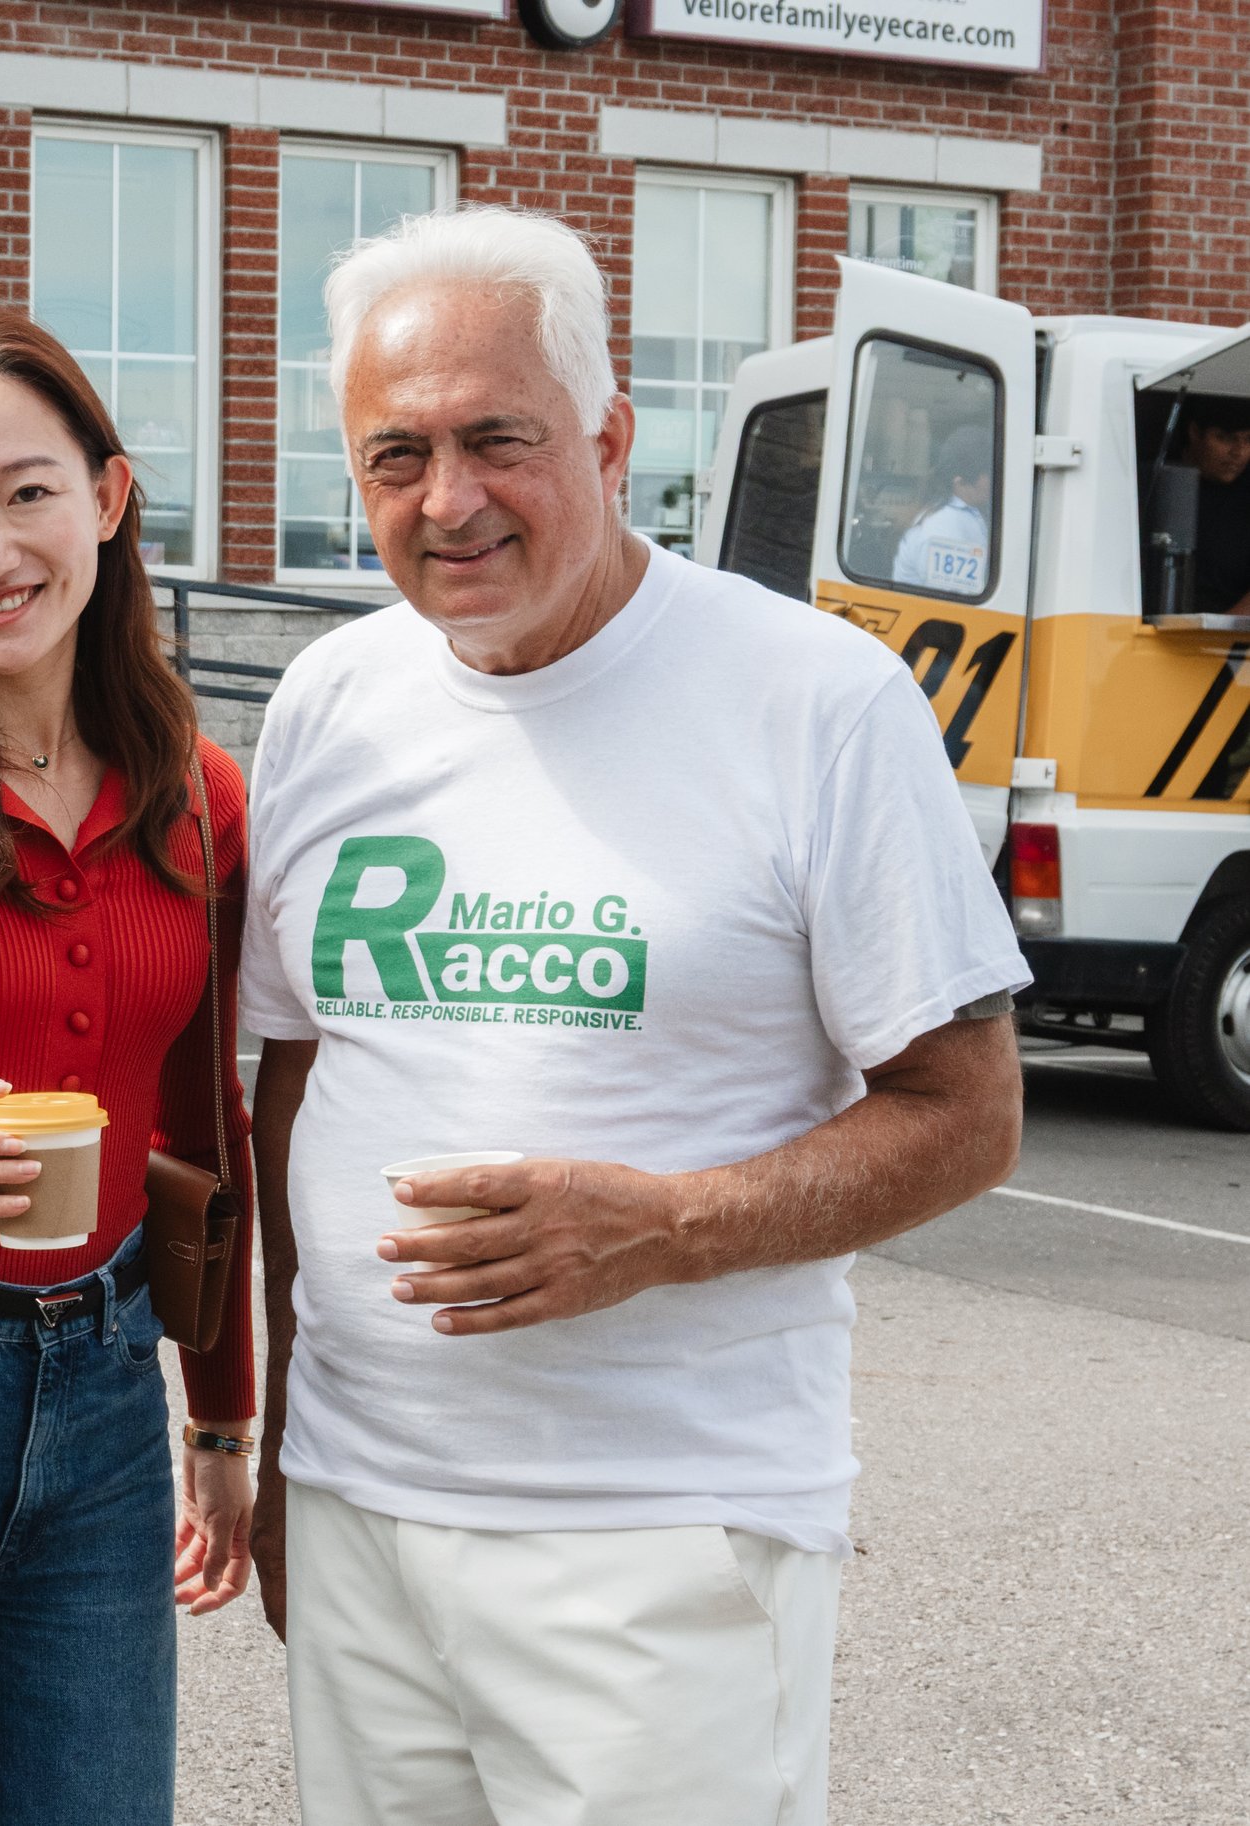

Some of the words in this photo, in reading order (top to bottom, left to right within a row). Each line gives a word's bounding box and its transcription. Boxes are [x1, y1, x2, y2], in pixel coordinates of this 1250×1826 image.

[934, 551, 978, 580] 1872
[449, 890, 575, 931] Mario
[592, 894, 642, 936] G.
[317, 1000, 387, 1019] RELIABLE.
[391, 1004, 508, 1024] RESPONSIBLE.
[514, 1008, 643, 1032] RESPONSIVE.
